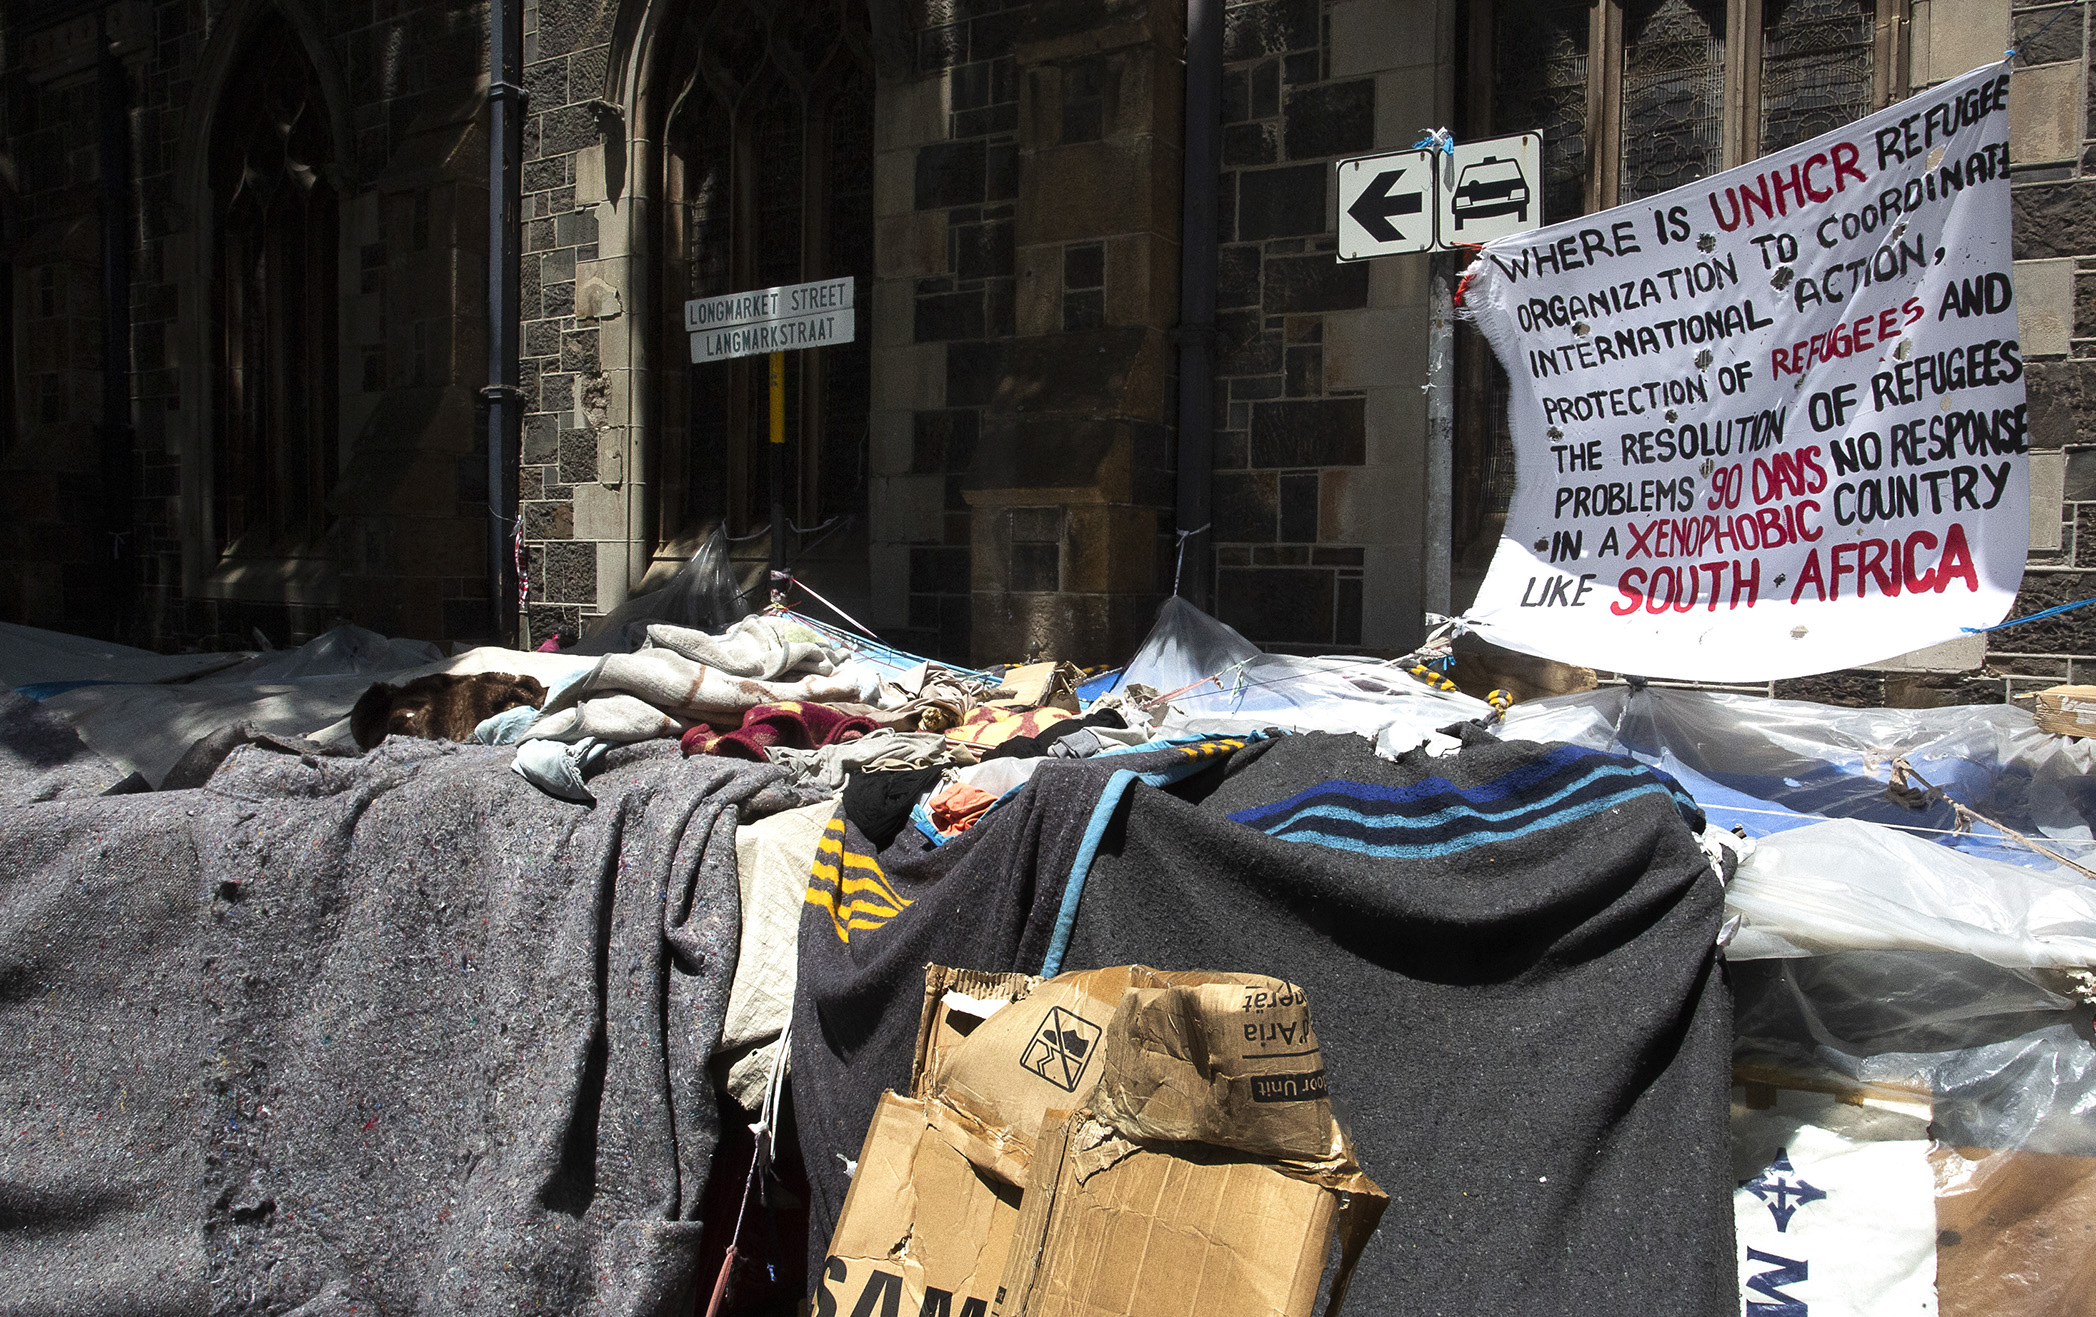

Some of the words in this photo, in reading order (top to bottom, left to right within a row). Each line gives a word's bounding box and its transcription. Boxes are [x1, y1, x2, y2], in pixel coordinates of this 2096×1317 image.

[1490, 221, 1641, 284] WHERE
[1654, 206, 1691, 245] IS
[1709, 142, 1868, 232] UNHCR
[690, 293, 778, 325] LONGMARKET
[791, 283, 846, 311] STREET
[1517, 252, 1739, 333] ORGANIZATION
[1750, 233, 1798, 270] TO
[1529, 300, 1774, 378] INTERNATIONAL
[1794, 233, 1946, 313] ACTION,
[706, 317, 835, 356] LANGMARKSTRAAT
[1542, 374, 1708, 425] PROTECTION
[1718, 361, 1753, 395] OF
[1772, 297, 1924, 382] REFUGEES
[1939, 272, 2012, 321] AND
[1550, 440, 1602, 474] THE
[1621, 406, 1786, 466] RESOLUTION
[1809, 384, 1857, 432] OF
[1871, 340, 2023, 412] REFUGEES
[1550, 530, 1582, 563] IN
[1598, 526, 1619, 558] A
[1625, 500, 1823, 560] XENOPHOBIC
[1833, 461, 2011, 526] COUNTRY
[1554, 475, 1695, 519] PROBLEMS
[1707, 463, 1743, 511] 90
[1752, 445, 1827, 505] DAYS
[1829, 431, 1882, 476] NO
[1891, 403, 2029, 468] RESPONSE
[1520, 573, 1596, 607] LIKE
[1610, 558, 1760, 616] SOUTH
[1791, 523, 1978, 604] AFRICA
[1258, 1080, 1297, 1097] Unit
